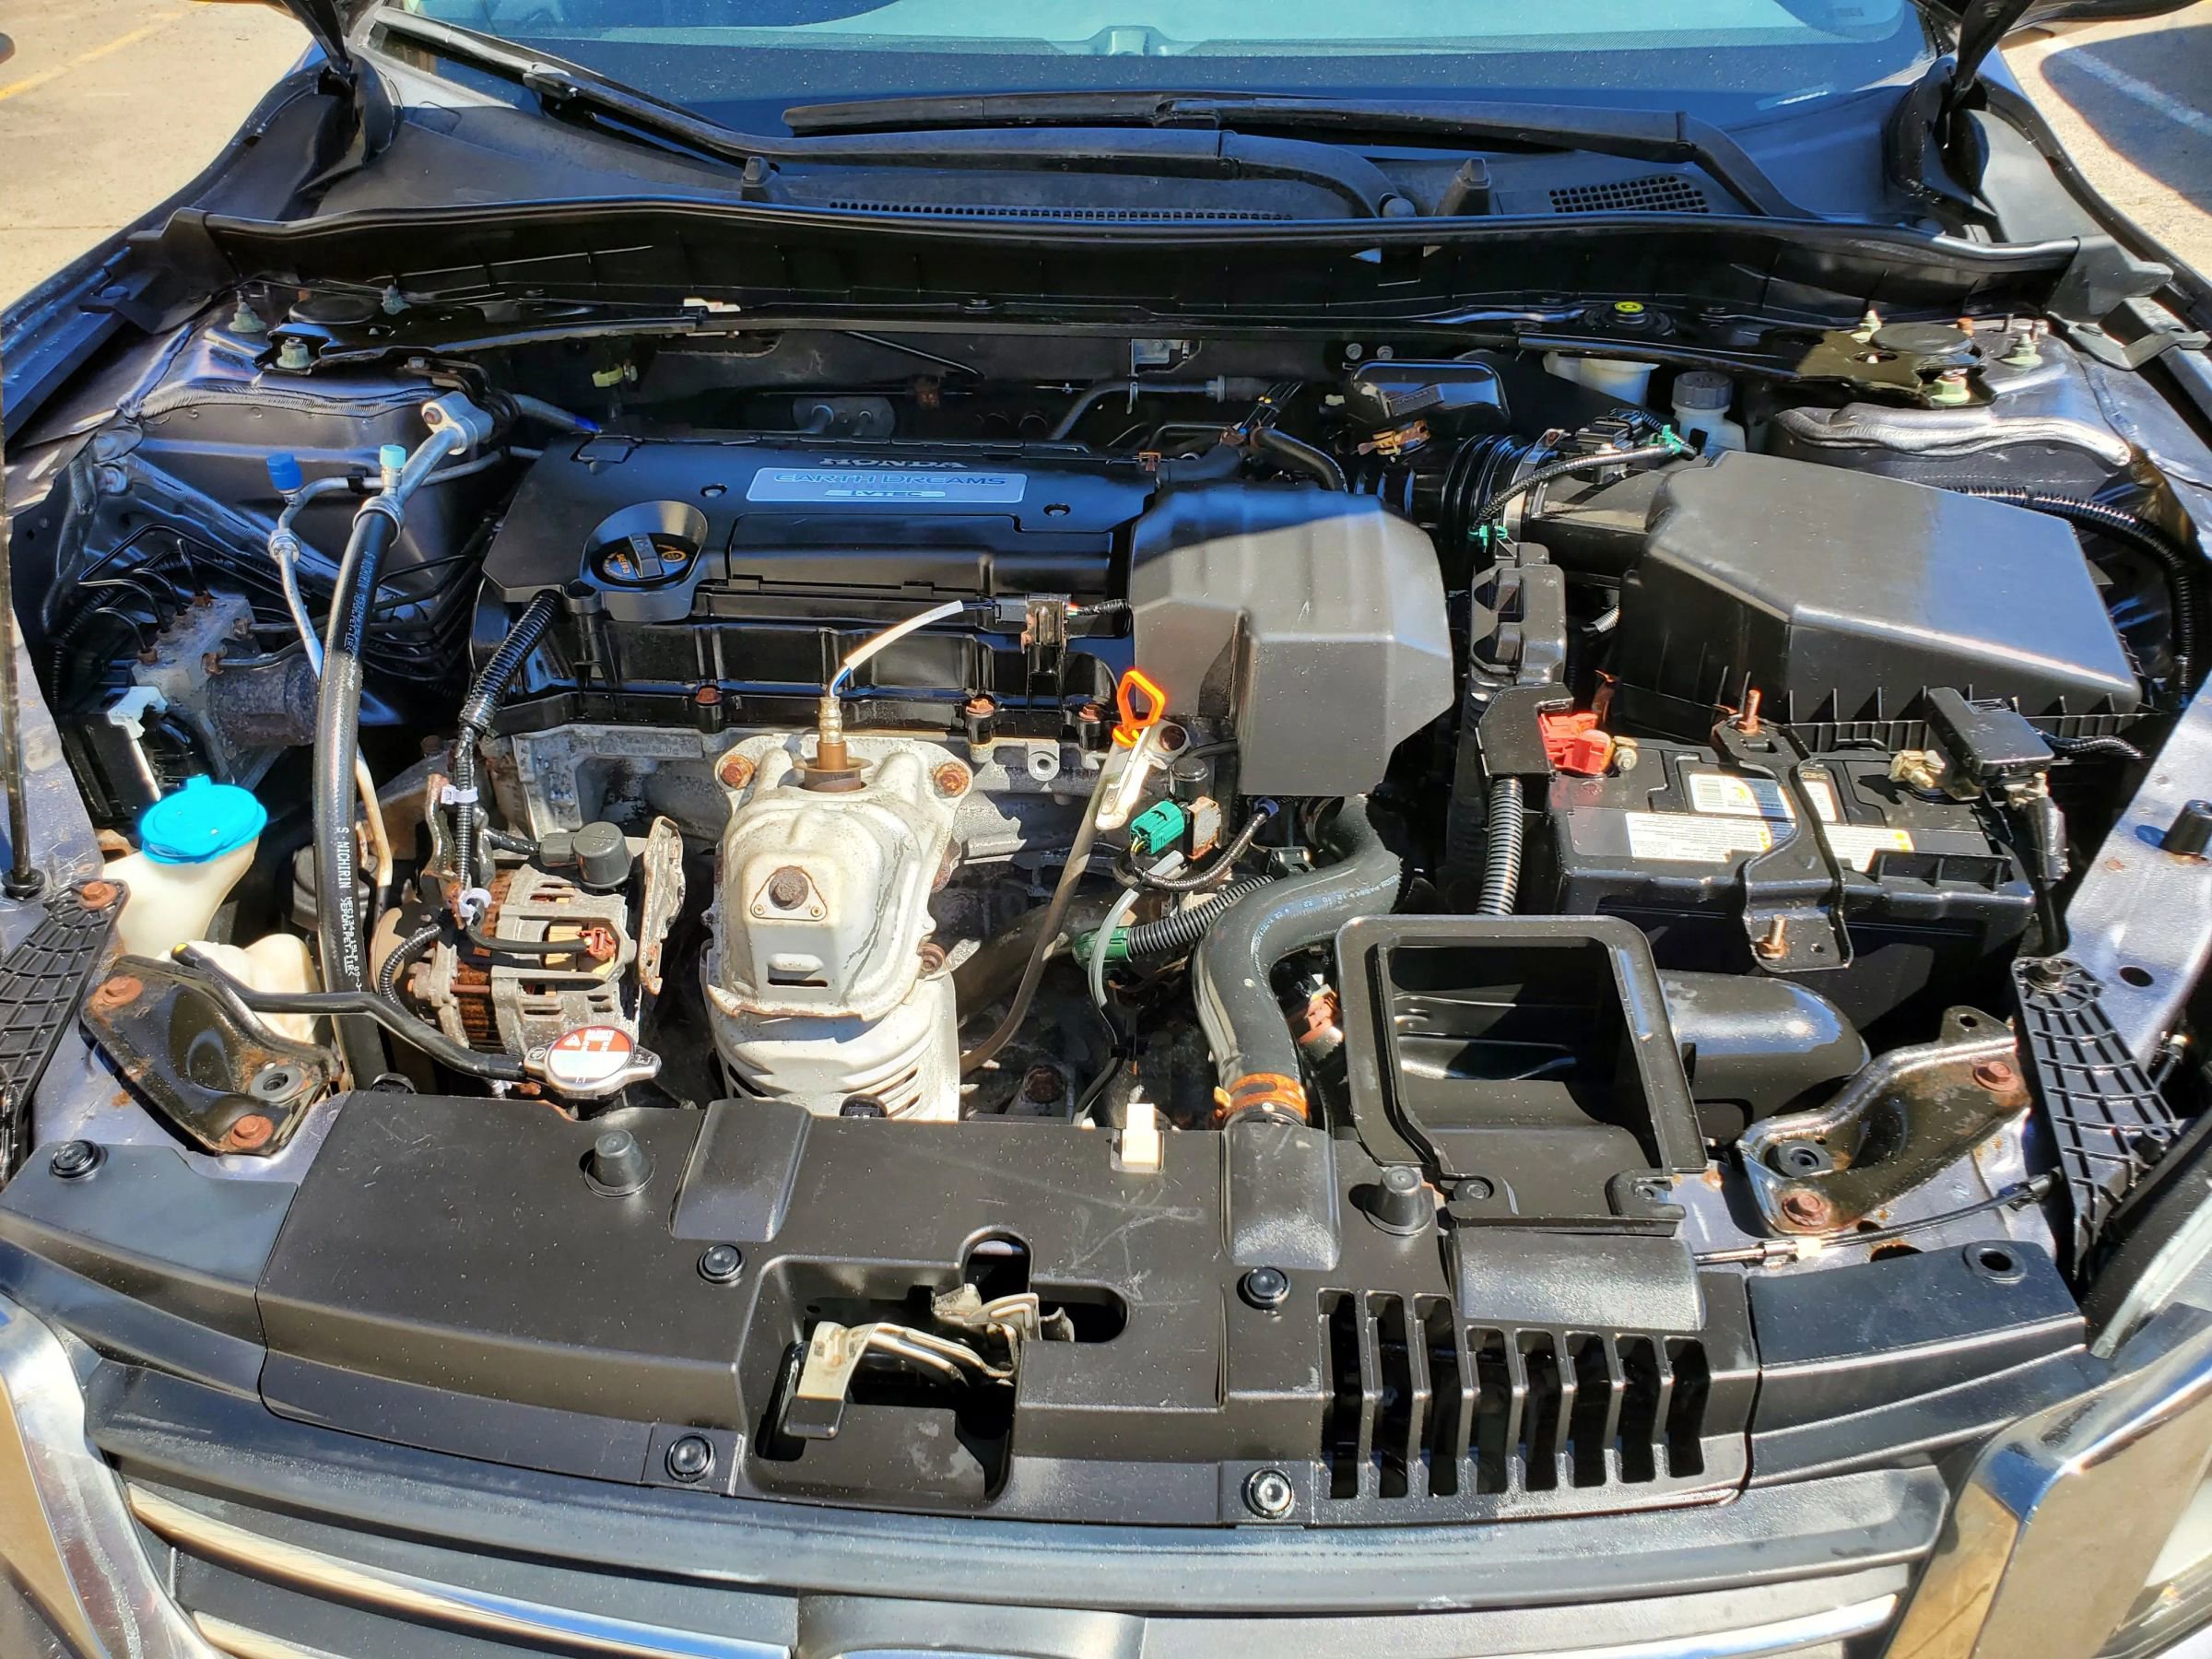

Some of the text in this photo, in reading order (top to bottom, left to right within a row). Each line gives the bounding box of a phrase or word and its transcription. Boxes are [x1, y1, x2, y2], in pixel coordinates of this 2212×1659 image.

[818, 458, 968, 468] HONDA
[774, 474, 1006, 486] EARTH DREAMS
